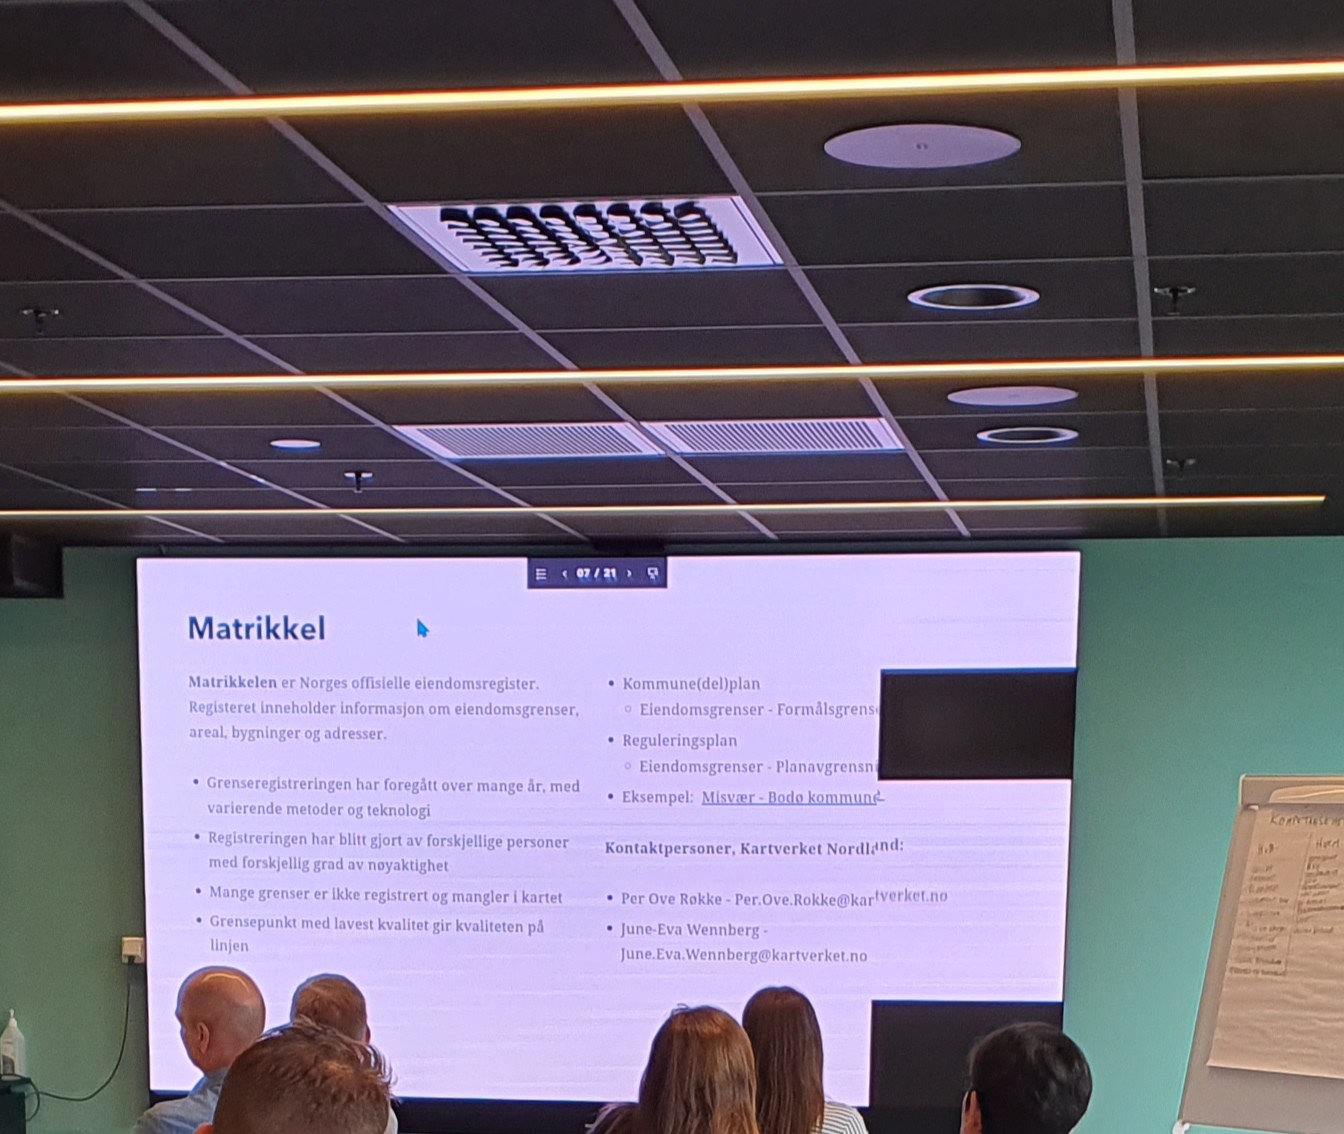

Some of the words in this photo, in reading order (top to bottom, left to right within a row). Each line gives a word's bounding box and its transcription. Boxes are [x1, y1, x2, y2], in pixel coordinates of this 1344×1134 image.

[576, 567, 591, 578] 07
[603, 567, 616, 578] 21
[188, 615, 324, 641] Matrikkel
[188, 675, 277, 689] Matrikkelen
[281, 679, 296, 689] er
[299, 677, 347, 693] Norges
[351, 676, 410, 690] offisielle
[414, 676, 539, 694] eiendomsregister.
[623, 676, 760, 695] Kommune(del)plan
[189, 700, 256, 717] Registeret
[260, 701, 336, 715] inneholder
[340, 701, 424, 719] informasjon
[428, 705, 450, 716] om
[454, 702, 579, 720] eiendomsgrenser,
[639, 702, 764, 720] Eiendomsgrenser
[189, 725, 227, 740] areal,
[231, 725, 301, 743] bygninger
[304, 729, 320, 744] og
[324, 727, 387, 741] adresser.
[622, 733, 737, 751] Reguleringsplan
[639, 759, 763, 777] Eiendomsgrenser
[206, 776, 351, 794] Grenseregistreringen
[355, 777, 380, 792] har
[383, 777, 437, 795] foregått
[441, 782, 473, 793] over
[476, 782, 523, 796] mange
[549, 779, 580, 793] med
[622, 790, 693, 808] Eksempel:
[701, 790, 755, 804] Misvær
[768, 790, 803, 804] Bodø
[207, 801, 282, 815] varierende
[286, 802, 343, 817] metoder
[347, 806, 363, 820] og
[366, 803, 430, 821] teknologi
[208, 831, 307, 849] Registreringen
[311, 832, 335, 846] har
[338, 832, 366, 847] blitt
[369, 833, 402, 850] gjort
[406, 837, 423, 847] av
[426, 834, 502, 852] forskjellige
[506, 838, 569, 852] personer
[605, 841, 735, 859] Kontaktpersoner,
[740, 842, 822, 856] Kartverket
[208, 856, 238, 869] med
[242, 856, 309, 874] forskjellig
[312, 857, 344, 874] grad
[347, 861, 364, 871] av
[367, 858, 448, 876] nøyaktighet
[209, 886, 254, 902] Mange
[258, 889, 310, 903] grenser
[313, 891, 328, 901] er
[331, 887, 360, 901] ikke
[364, 888, 428, 905] registrert
[431, 892, 448, 906] og
[451, 890, 509, 907] mangler
[521, 890, 562, 904] kartet
[621, 892, 645, 905] Per
[648, 893, 675, 906] Ove
[679, 892, 722, 906] Røkke
[209, 915, 296, 933] Grensepunkt
[301, 916, 330, 930] med
[334, 917, 374, 931] lavest
[377, 917, 429, 932] kvalitet
[432, 919, 452, 935] gir
[455, 919, 523, 934] kvaliteten
[527, 919, 544, 937] på
[619, 923, 682, 939] June-Eva
[686, 923, 759, 940] Wennberg
[210, 938, 248, 956] linjen
[620, 947, 867, 965] June.Eva.Wennberg@kartverket.no
